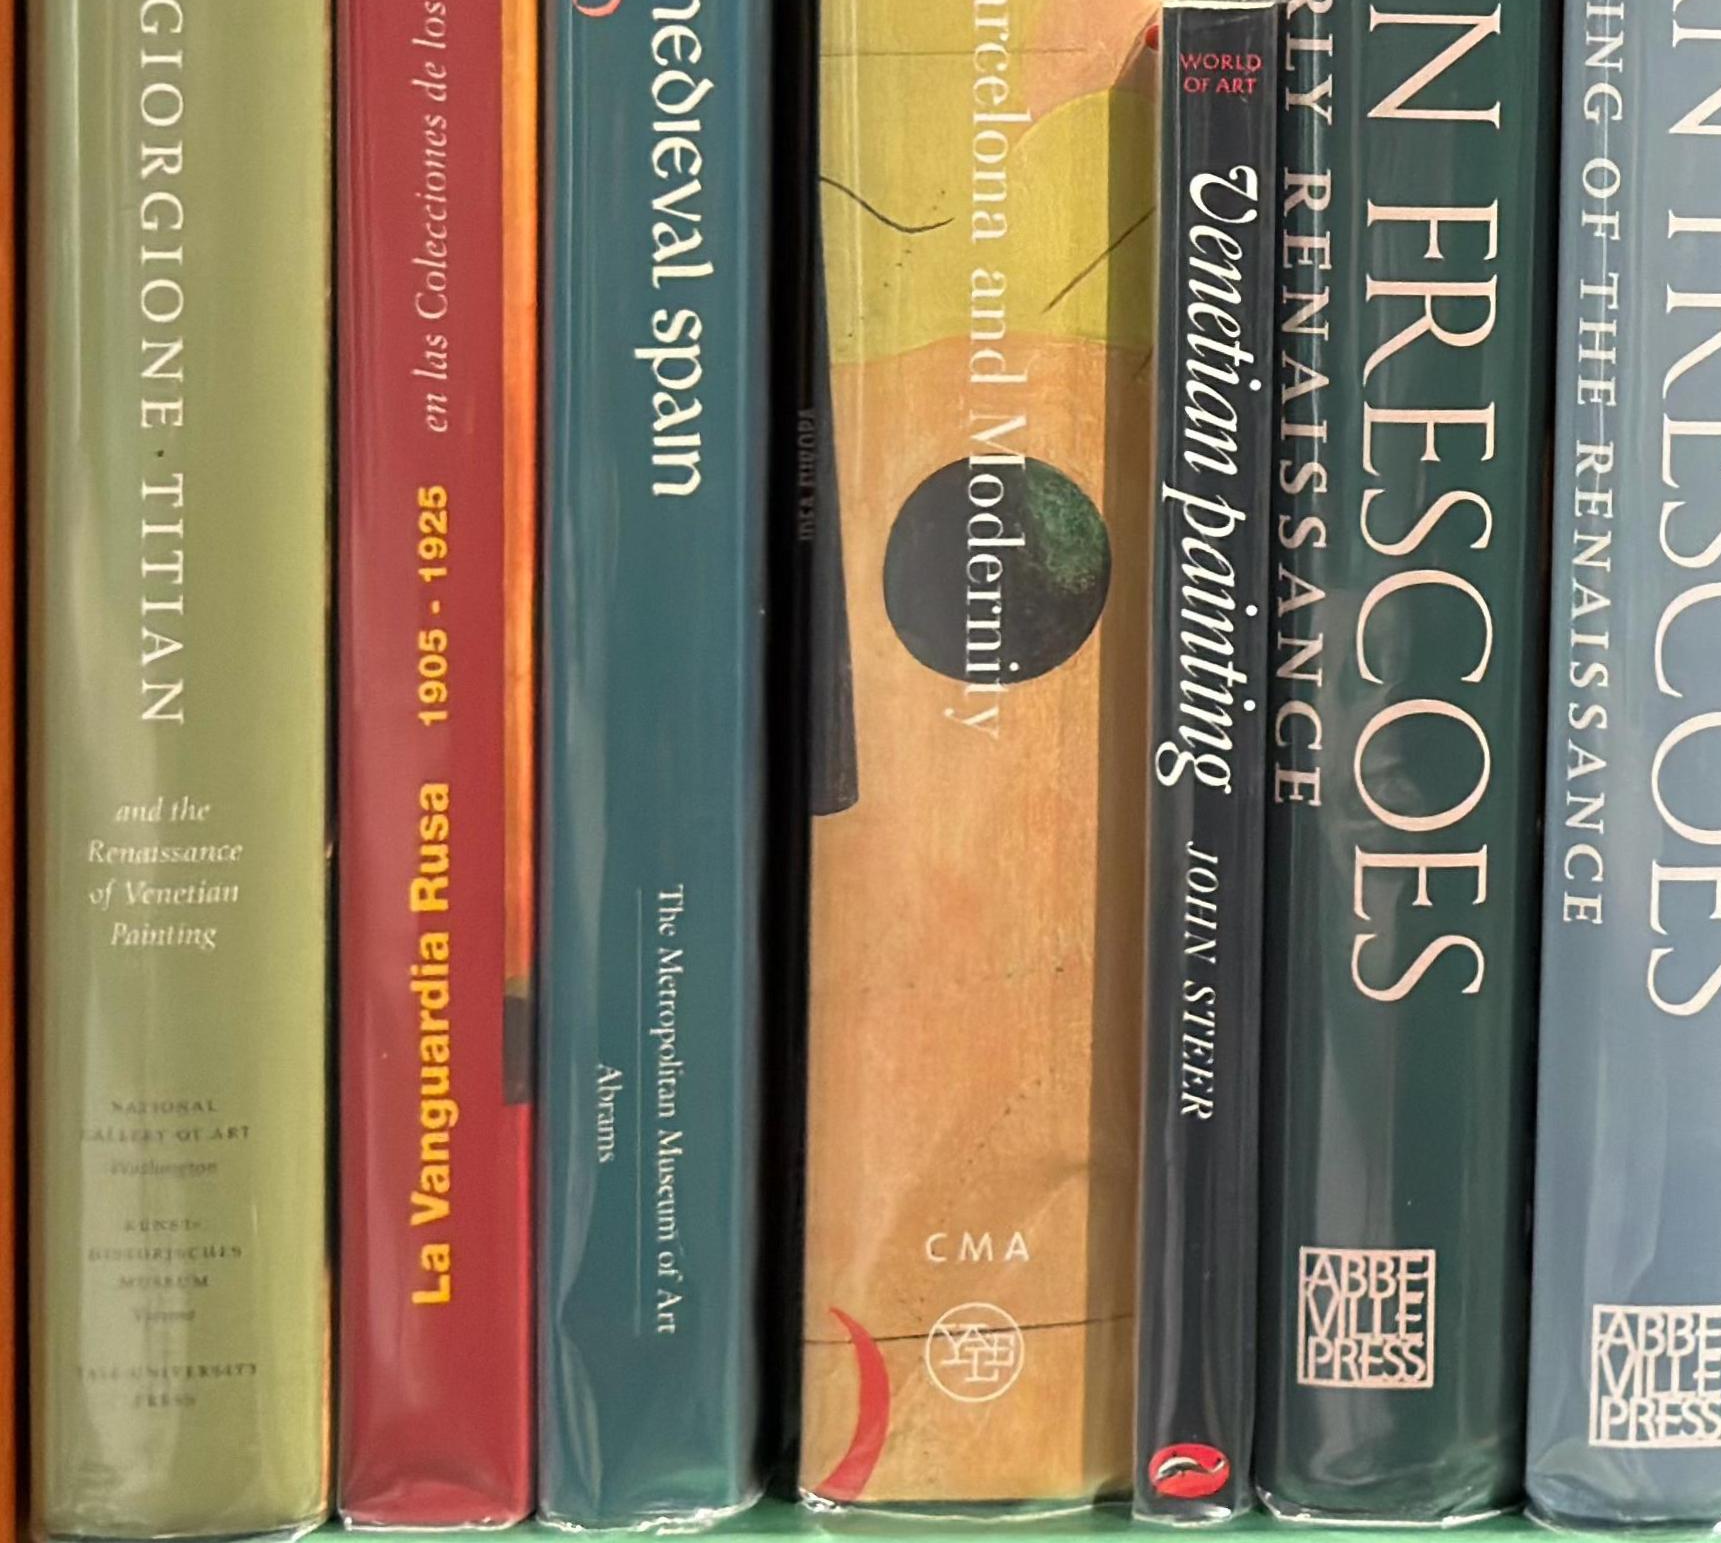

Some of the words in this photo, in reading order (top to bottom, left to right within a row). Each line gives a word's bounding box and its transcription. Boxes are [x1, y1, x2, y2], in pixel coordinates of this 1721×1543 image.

[413, 2, 447, 49] los
[1180, 53, 1262, 72] WORLD
[413, 63, 447, 102] de
[1184, 77, 1211, 93] OF
[1216, 77, 1257, 94] ART
[416, 116, 448, 320] Colecciones
[418, 336, 448, 380] las
[968, 267, 1027, 386] and
[1186, 166, 1262, 478] Venetian
[427, 395, 448, 433] en
[1272, 167, 1332, 806] RENAISSANCE
[419, 487, 448, 582] 1925
[942, 406, 1027, 743] Modernity
[142, 475, 184, 723] TITIAN
[1157, 481, 1257, 796] painting
[1352, 201, 1498, 1002] FRESCOES
[419, 630, 449, 726] 1905
[91, 842, 243, 864] Renaissance
[114, 799, 164, 825] and
[170, 797, 212, 825] the
[411, 785, 449, 912] Rusa
[91, 880, 116, 907] of
[126, 881, 239, 905] Venetian
[112, 923, 217, 950] Painting
[660, 885, 684, 937] The
[1185, 842, 1219, 964] JOHN
[411, 934, 459, 1226] Vanguardia
[653, 949, 684, 1118] Metropolitan
[1182, 982, 1216, 1120] STEER
[598, 1065, 623, 1163] Abrams
[658, 1131, 683, 1241] Museum
[413, 1245, 451, 1304] La
[659, 1253, 684, 1282] of
[927, 1229, 1034, 1263] CMA
[658, 1291, 683, 1333] Art
